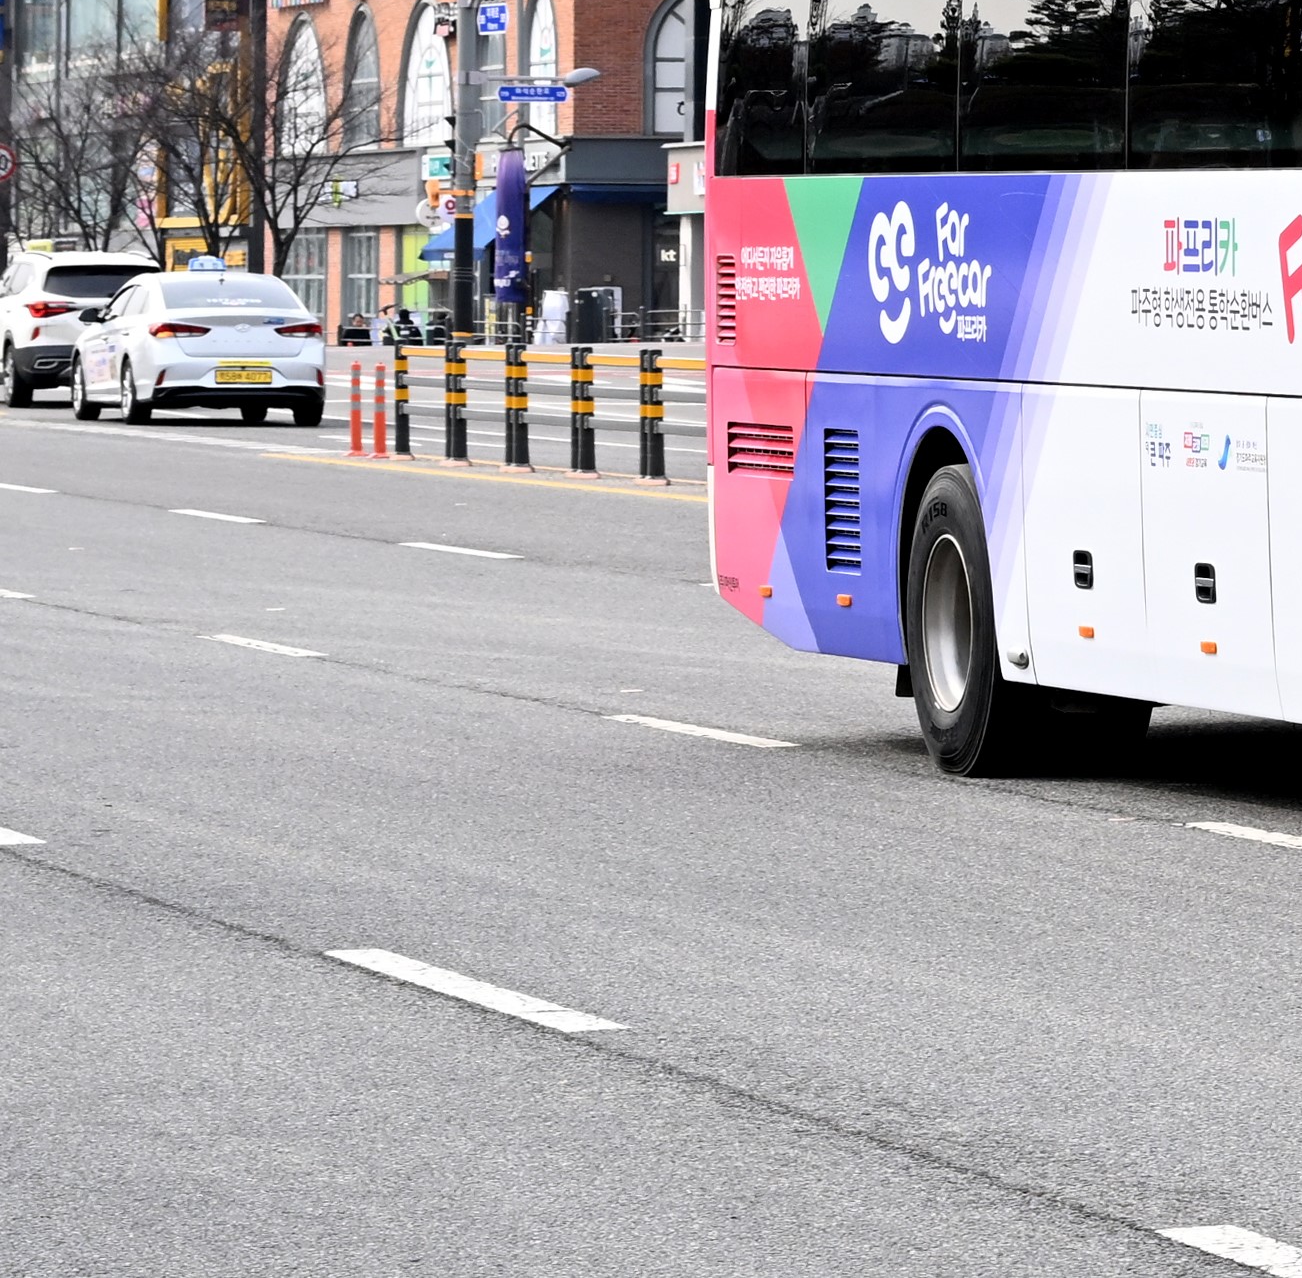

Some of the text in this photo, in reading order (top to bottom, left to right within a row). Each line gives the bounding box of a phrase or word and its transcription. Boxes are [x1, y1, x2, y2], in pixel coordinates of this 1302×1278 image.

[660, 248, 677, 263] kt
[934, 201, 970, 260] Far
[1163, 216, 1238, 278] 파프리카
[916, 258, 992, 328] Freecar
[1131, 287, 1274, 332] 파주형 학생전용 통학순환버스
[956, 314, 988, 344] 파프리카
